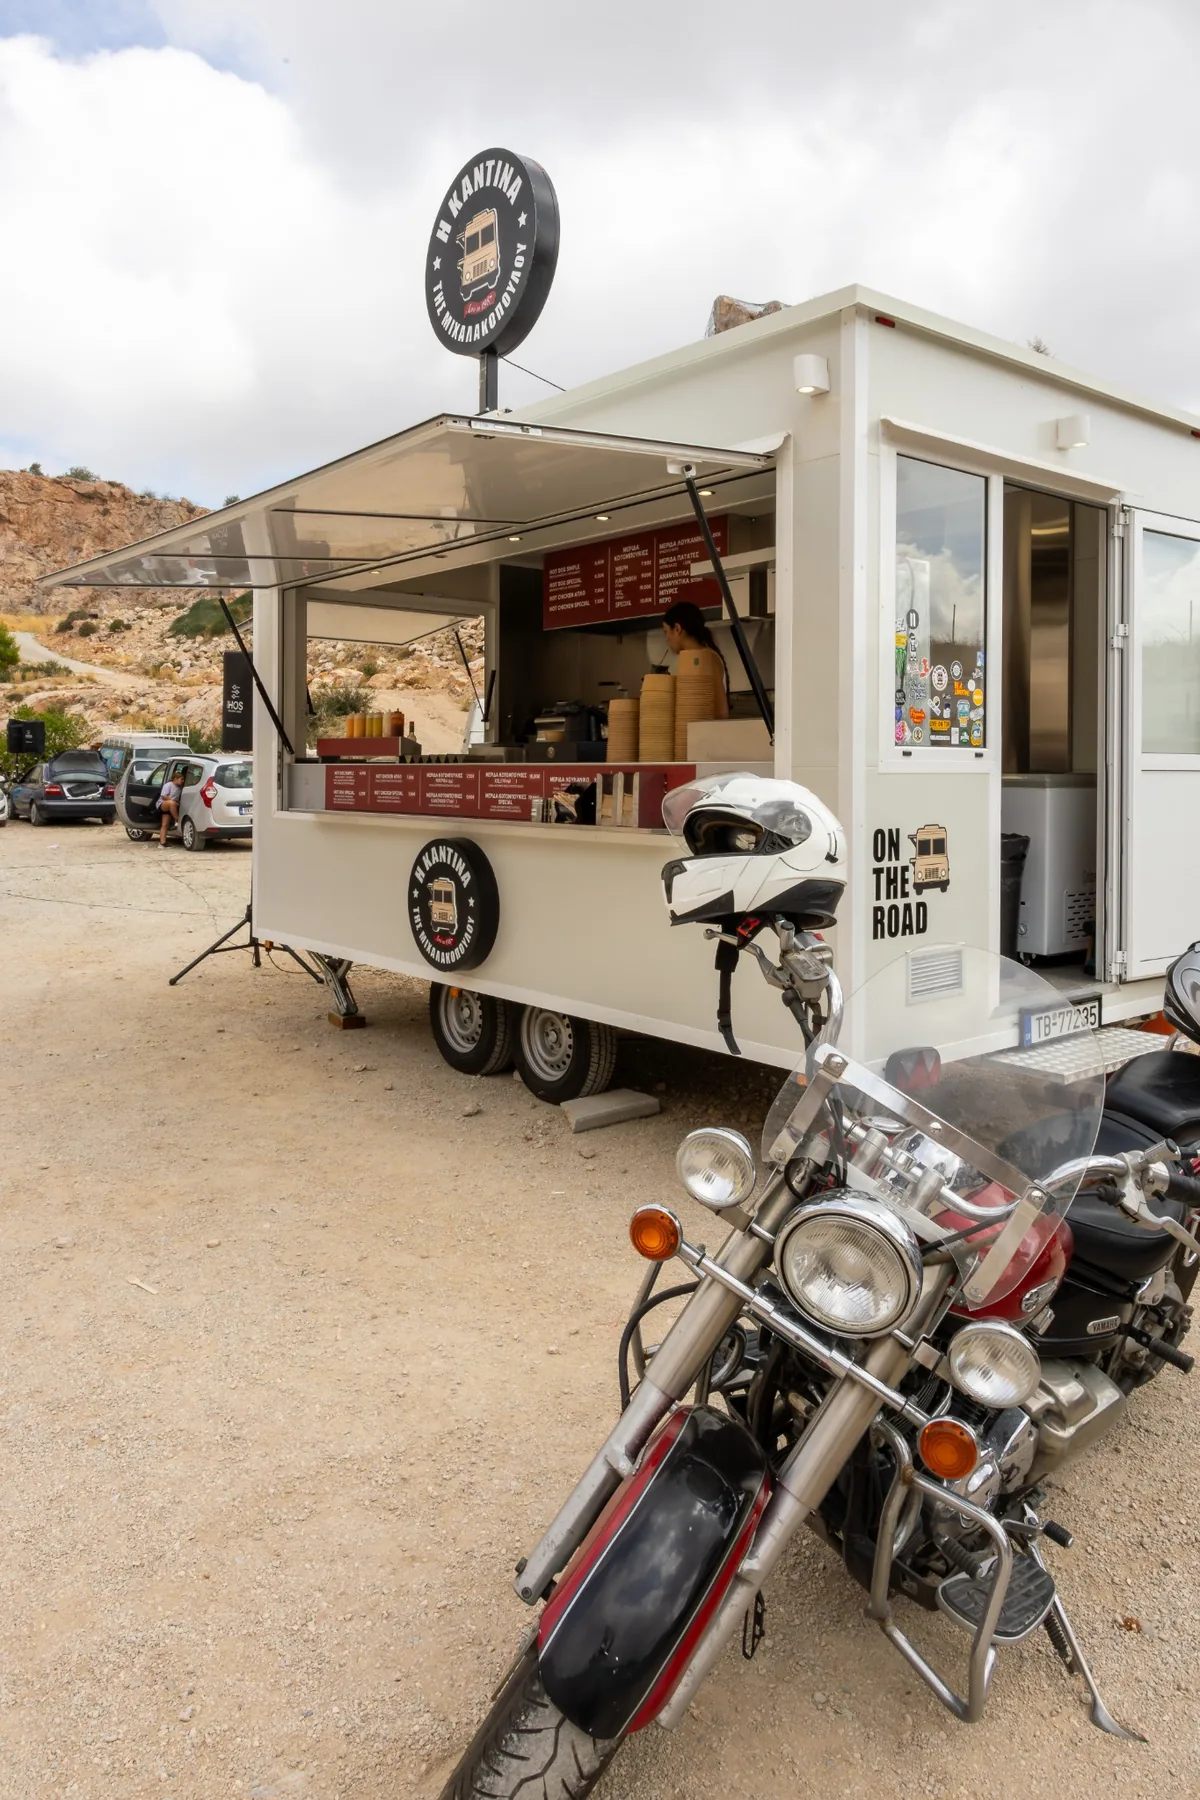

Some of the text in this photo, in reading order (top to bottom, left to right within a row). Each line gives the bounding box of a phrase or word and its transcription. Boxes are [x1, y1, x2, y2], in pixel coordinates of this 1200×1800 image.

[435, 159, 523, 244] Η ΚΑΝΤΙΝΑ
[432, 242, 527, 343] ΤΗΣ ΜΙΧΑΛΑΚΟΠΟΥΛΟΥ
[873, 828, 900, 863] ON
[414, 845, 472, 889] Η ΚΑΝΤΙΝΑ
[872, 865, 910, 901] THE
[412, 906, 475, 964] ΤΗΣ ΜΙΧΑΛΑΚΟΠΟΥΛΟΥ
[873, 901, 928, 940] ROAD
[1093, 1319, 1118, 1332] YAMAHA
